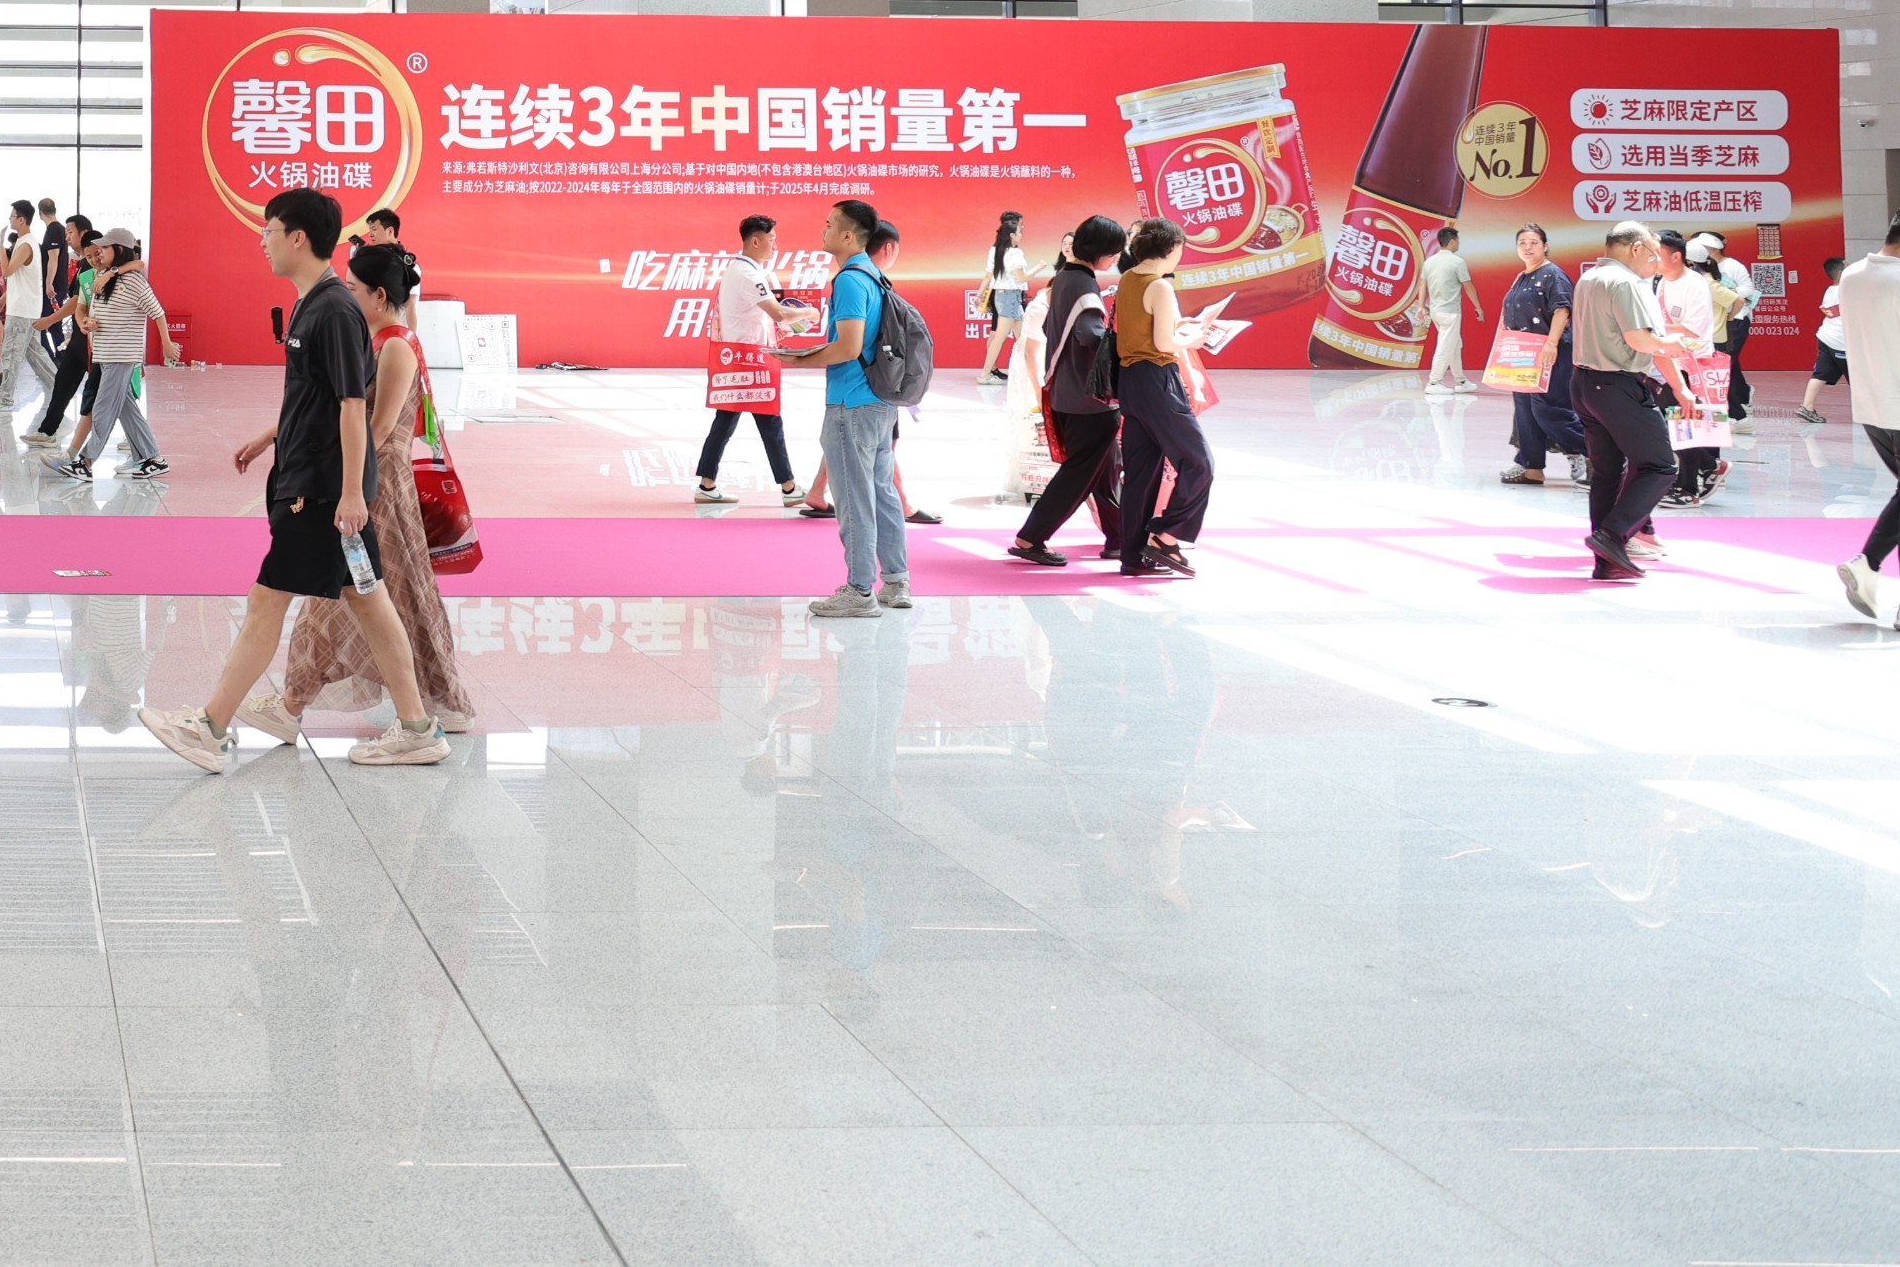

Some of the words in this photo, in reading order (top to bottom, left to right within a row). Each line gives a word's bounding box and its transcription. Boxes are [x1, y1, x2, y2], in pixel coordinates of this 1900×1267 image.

[231, 78, 385, 155] 馨田
[439, 83, 1087, 154] 连续3年中国销量第一
[1620, 99, 1759, 122] 芝麻限定产区
[1469, 115, 1540, 182] No.1
[1621, 144, 1760, 167] 选用当季芝麻
[248, 160, 373, 189] 火锅油碟
[1164, 162, 1245, 210] 馨田
[1181, 201, 1244, 227] 火锅油碟
[1623, 190, 1762, 213] 芝麻油低温压榨
[1333, 223, 1409, 281] 馨田
[1181, 251, 1309, 287] 连续3年中国销量第一
[1334, 265, 1394, 297] 火锅油碟
[1766, 326, 1782, 335] 023
[1784, 326, 1800, 335] 024
